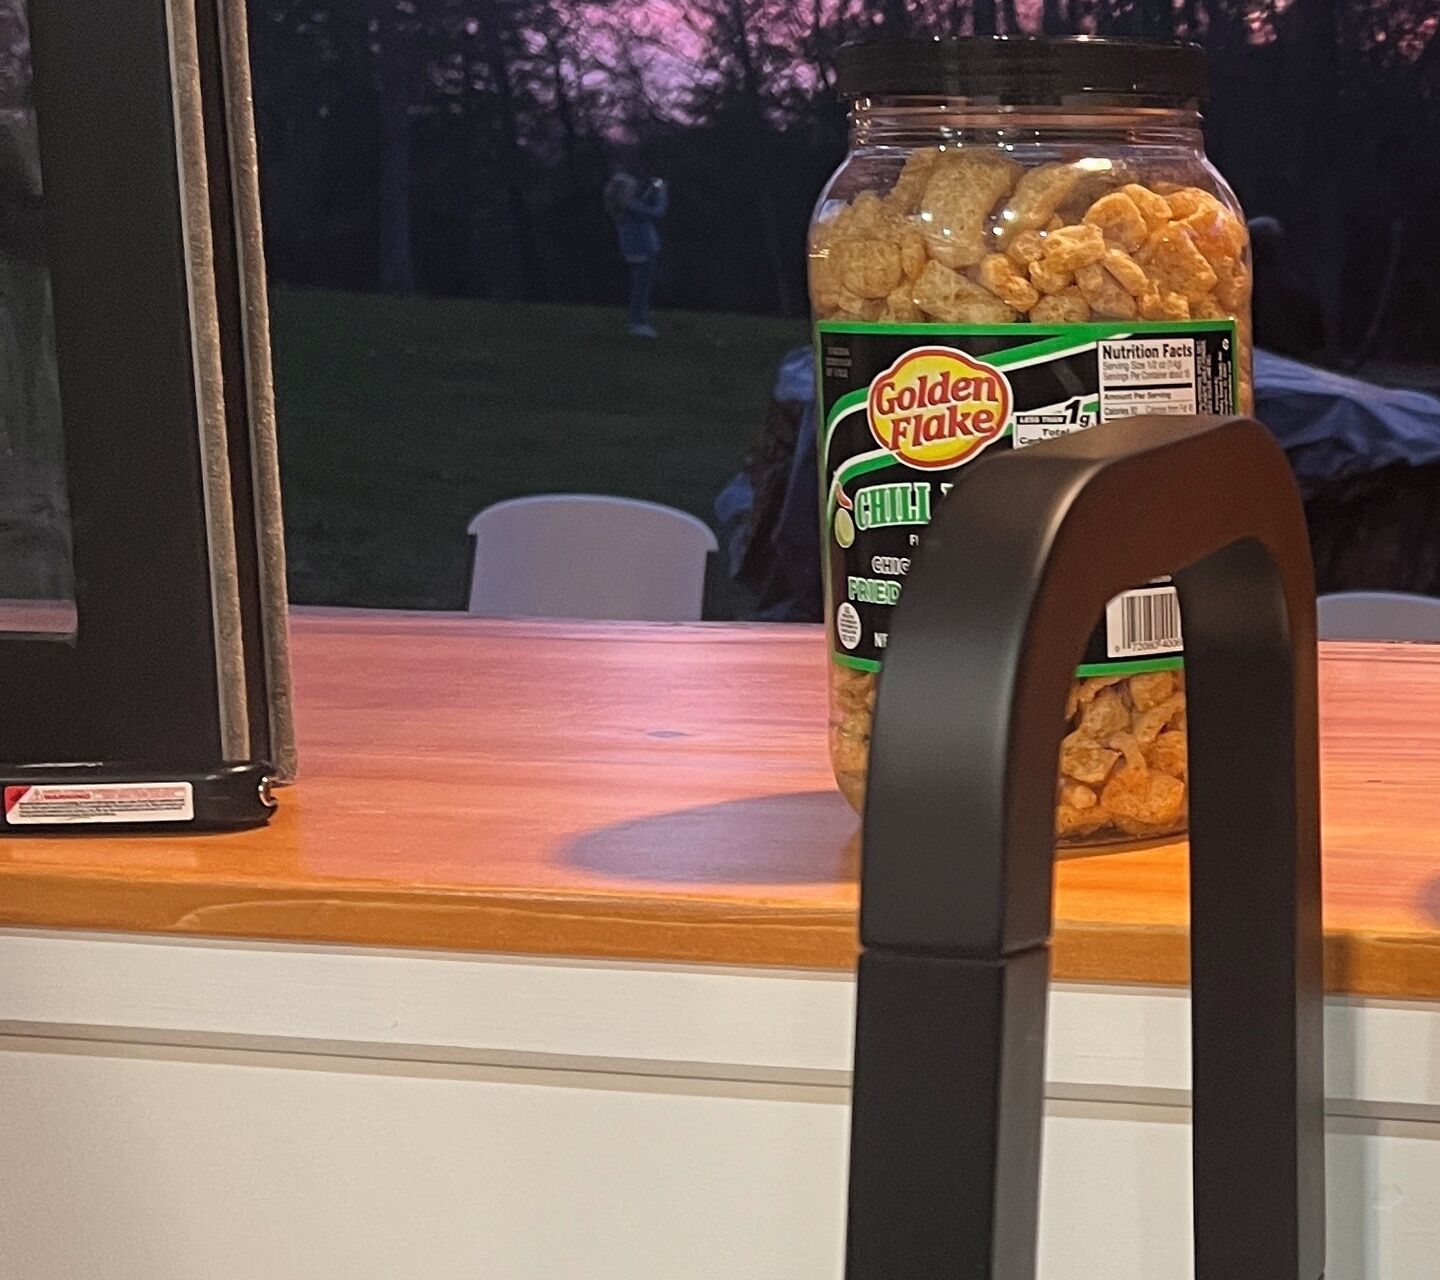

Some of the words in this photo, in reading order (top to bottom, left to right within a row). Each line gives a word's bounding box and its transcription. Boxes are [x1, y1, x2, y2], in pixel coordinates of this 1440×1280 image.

[1103, 345, 1159, 360] Nutrition
[1162, 344, 1192, 358] Facts
[876, 370, 998, 415] Golden
[890, 405, 996, 450] Flake
[854, 482, 931, 531] CHILI
[848, 576, 902, 605] FRIED
